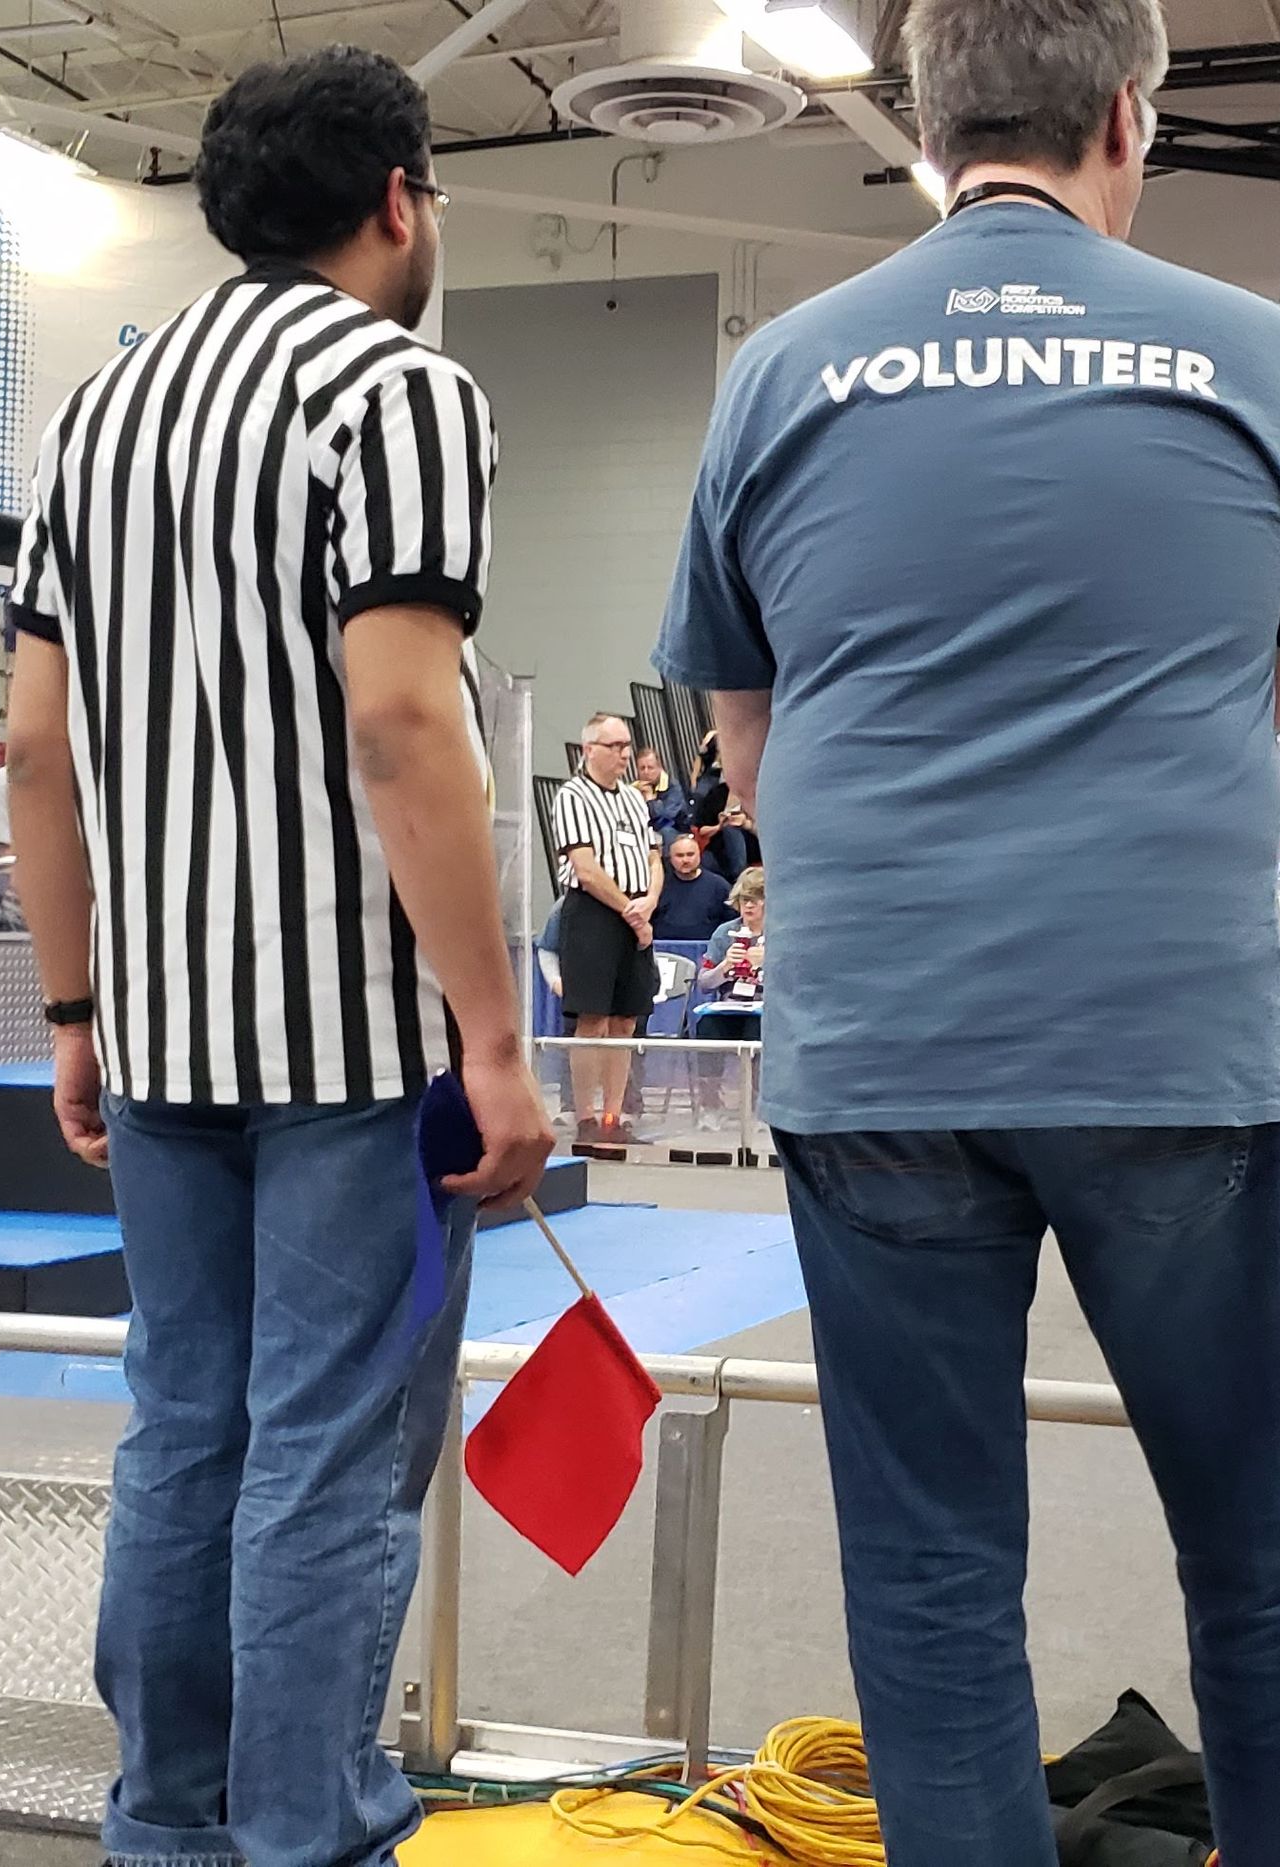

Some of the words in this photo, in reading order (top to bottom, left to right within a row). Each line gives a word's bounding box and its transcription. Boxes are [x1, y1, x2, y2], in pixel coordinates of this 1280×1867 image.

[1001, 295, 1063, 305] ROBOTICS
[1001, 305, 1086, 315] COMPETITION
[820, 337, 1219, 404] VOLUNTEER
